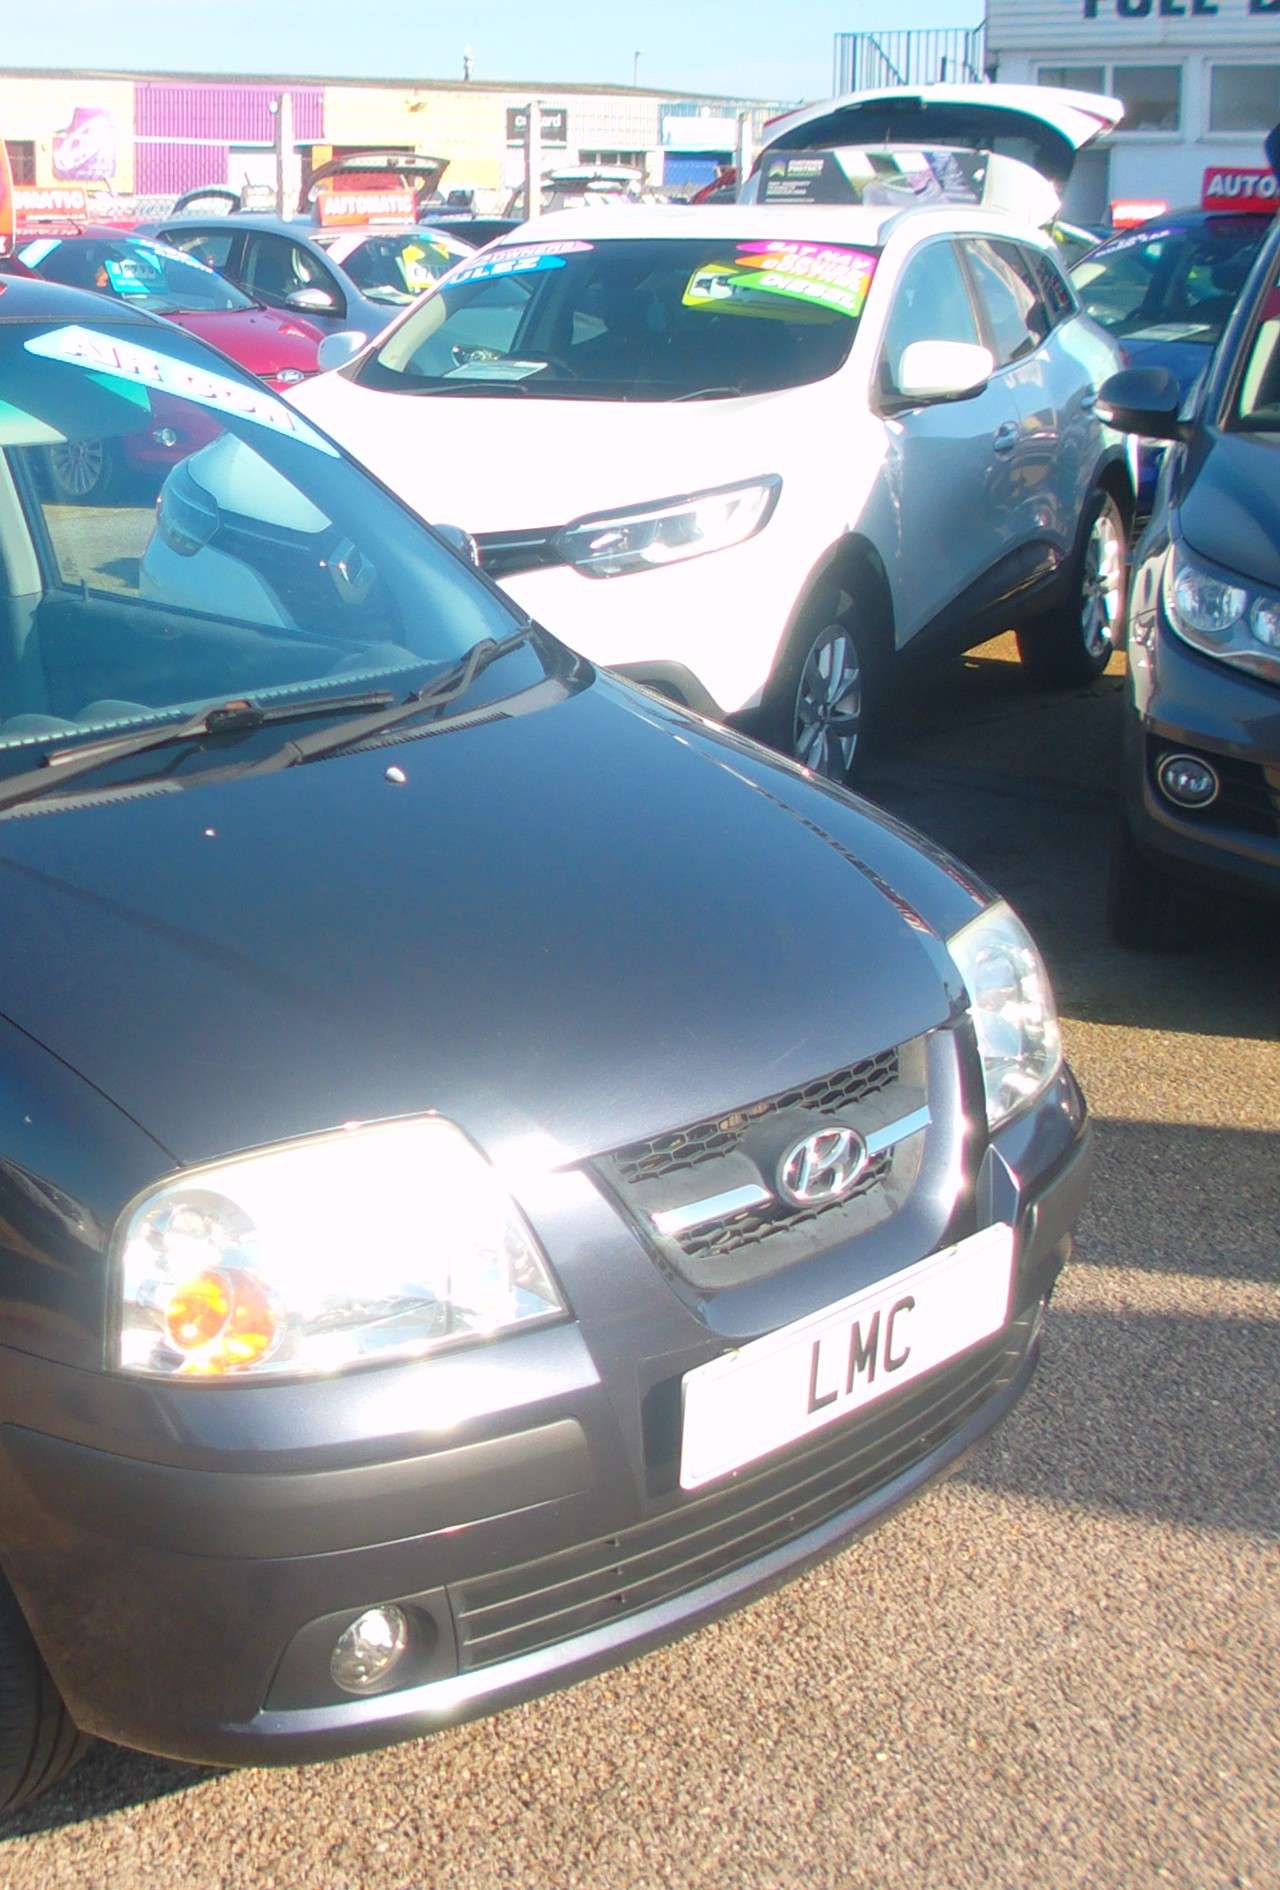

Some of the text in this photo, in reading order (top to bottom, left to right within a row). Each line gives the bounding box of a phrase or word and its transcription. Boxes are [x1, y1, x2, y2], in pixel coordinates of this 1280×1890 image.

[1207, 174, 1279, 198] AUTO
[324, 195, 413, 215] AUTOMATIC
[806, 1295, 916, 1415] LMC
